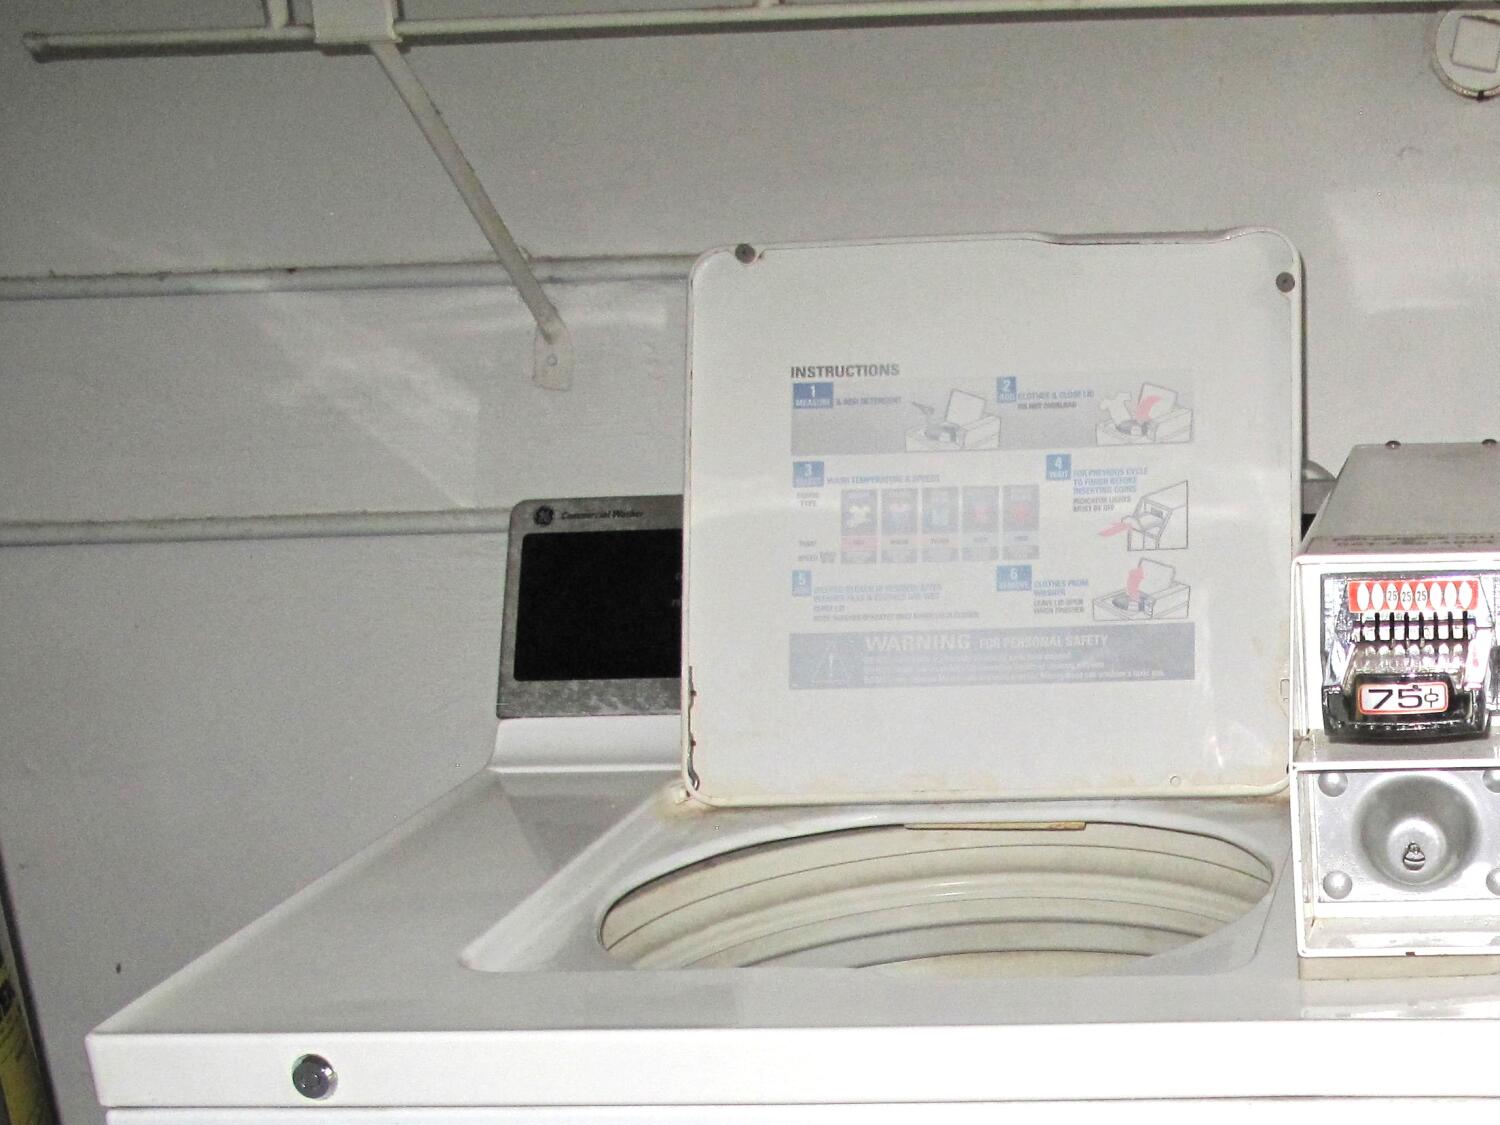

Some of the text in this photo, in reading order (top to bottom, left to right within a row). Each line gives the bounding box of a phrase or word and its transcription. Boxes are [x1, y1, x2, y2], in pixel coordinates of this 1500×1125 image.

[791, 364, 900, 378] INSTRUCTIONS
[810, 386, 816, 397] 1
[1003, 380, 1010, 391] 2
[1055, 456, 1062, 470] 4
[805, 464, 812, 476] 3
[1010, 568, 1017, 580] 6
[1388, 591, 1427, 602] 25 25 25
[866, 634, 1108, 651] WARNING FOR PERSONAL SAFETY
[1368, 687, 1439, 709] 75¢
